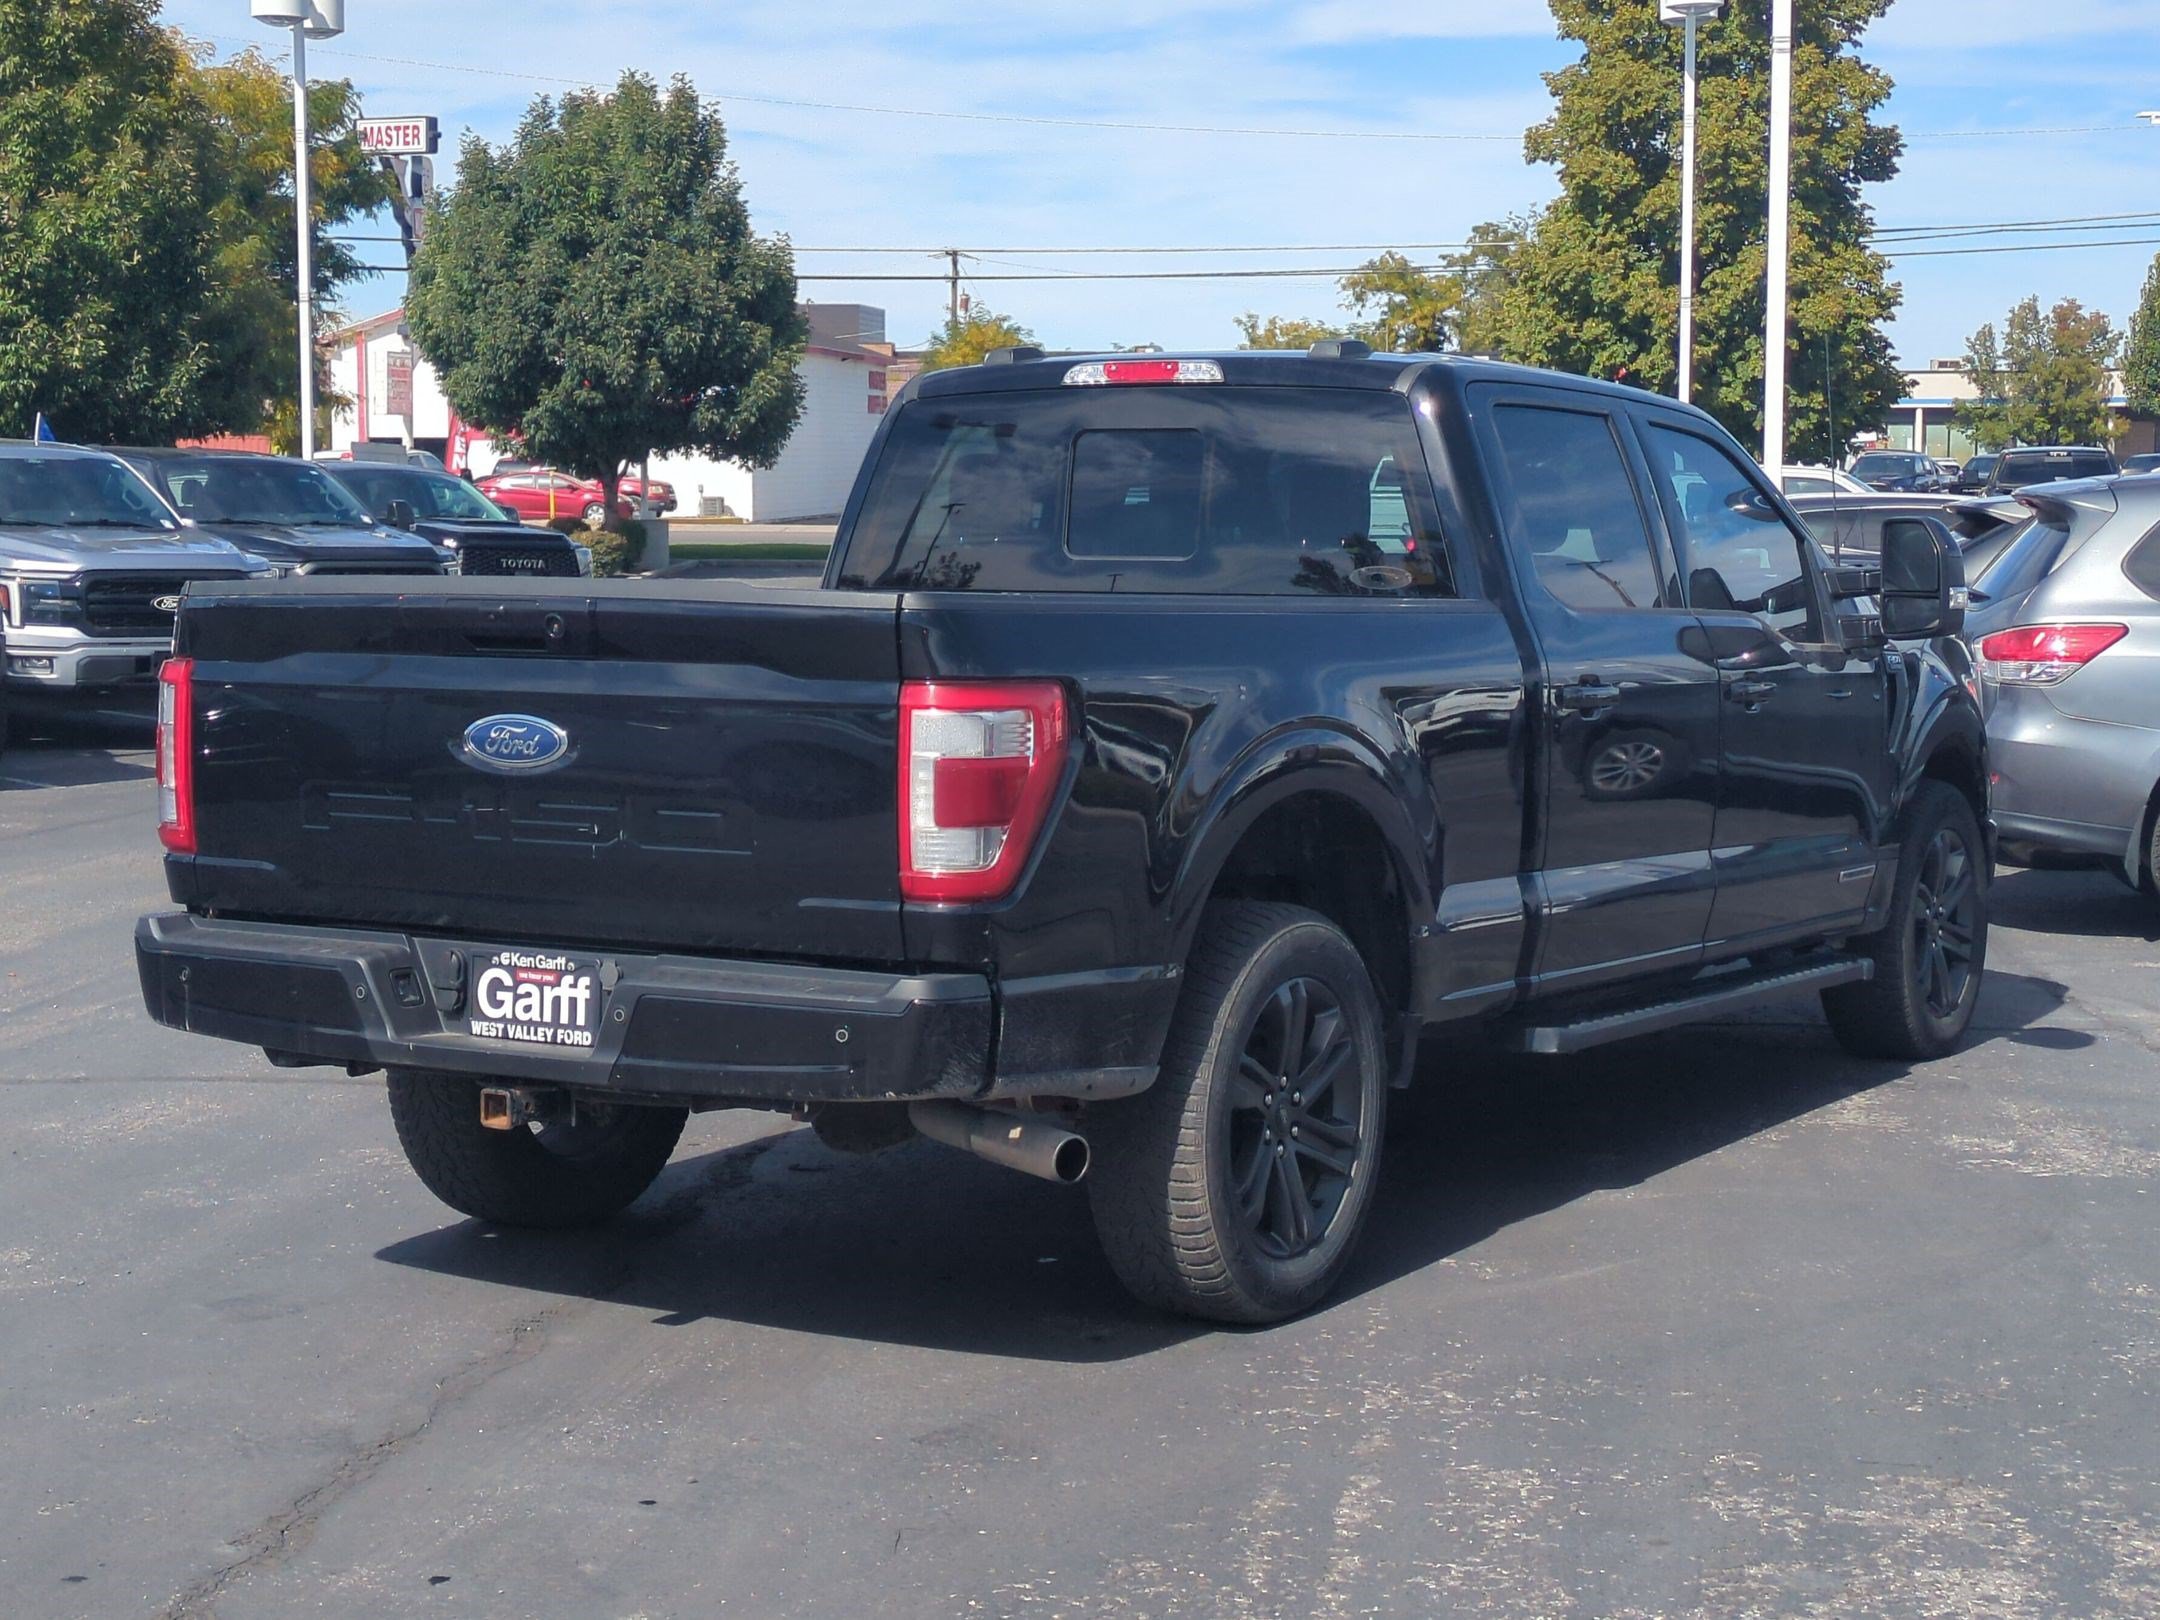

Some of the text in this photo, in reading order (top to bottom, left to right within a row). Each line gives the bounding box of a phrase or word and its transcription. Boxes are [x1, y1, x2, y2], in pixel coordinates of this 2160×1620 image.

[363, 124, 421, 147] MASTER
[501, 559, 545, 569] TOYOTA
[485, 724, 541, 755] Ford
[477, 967, 591, 1026] Garff
[471, 1020, 592, 1046] WEST VALLEY FORD
